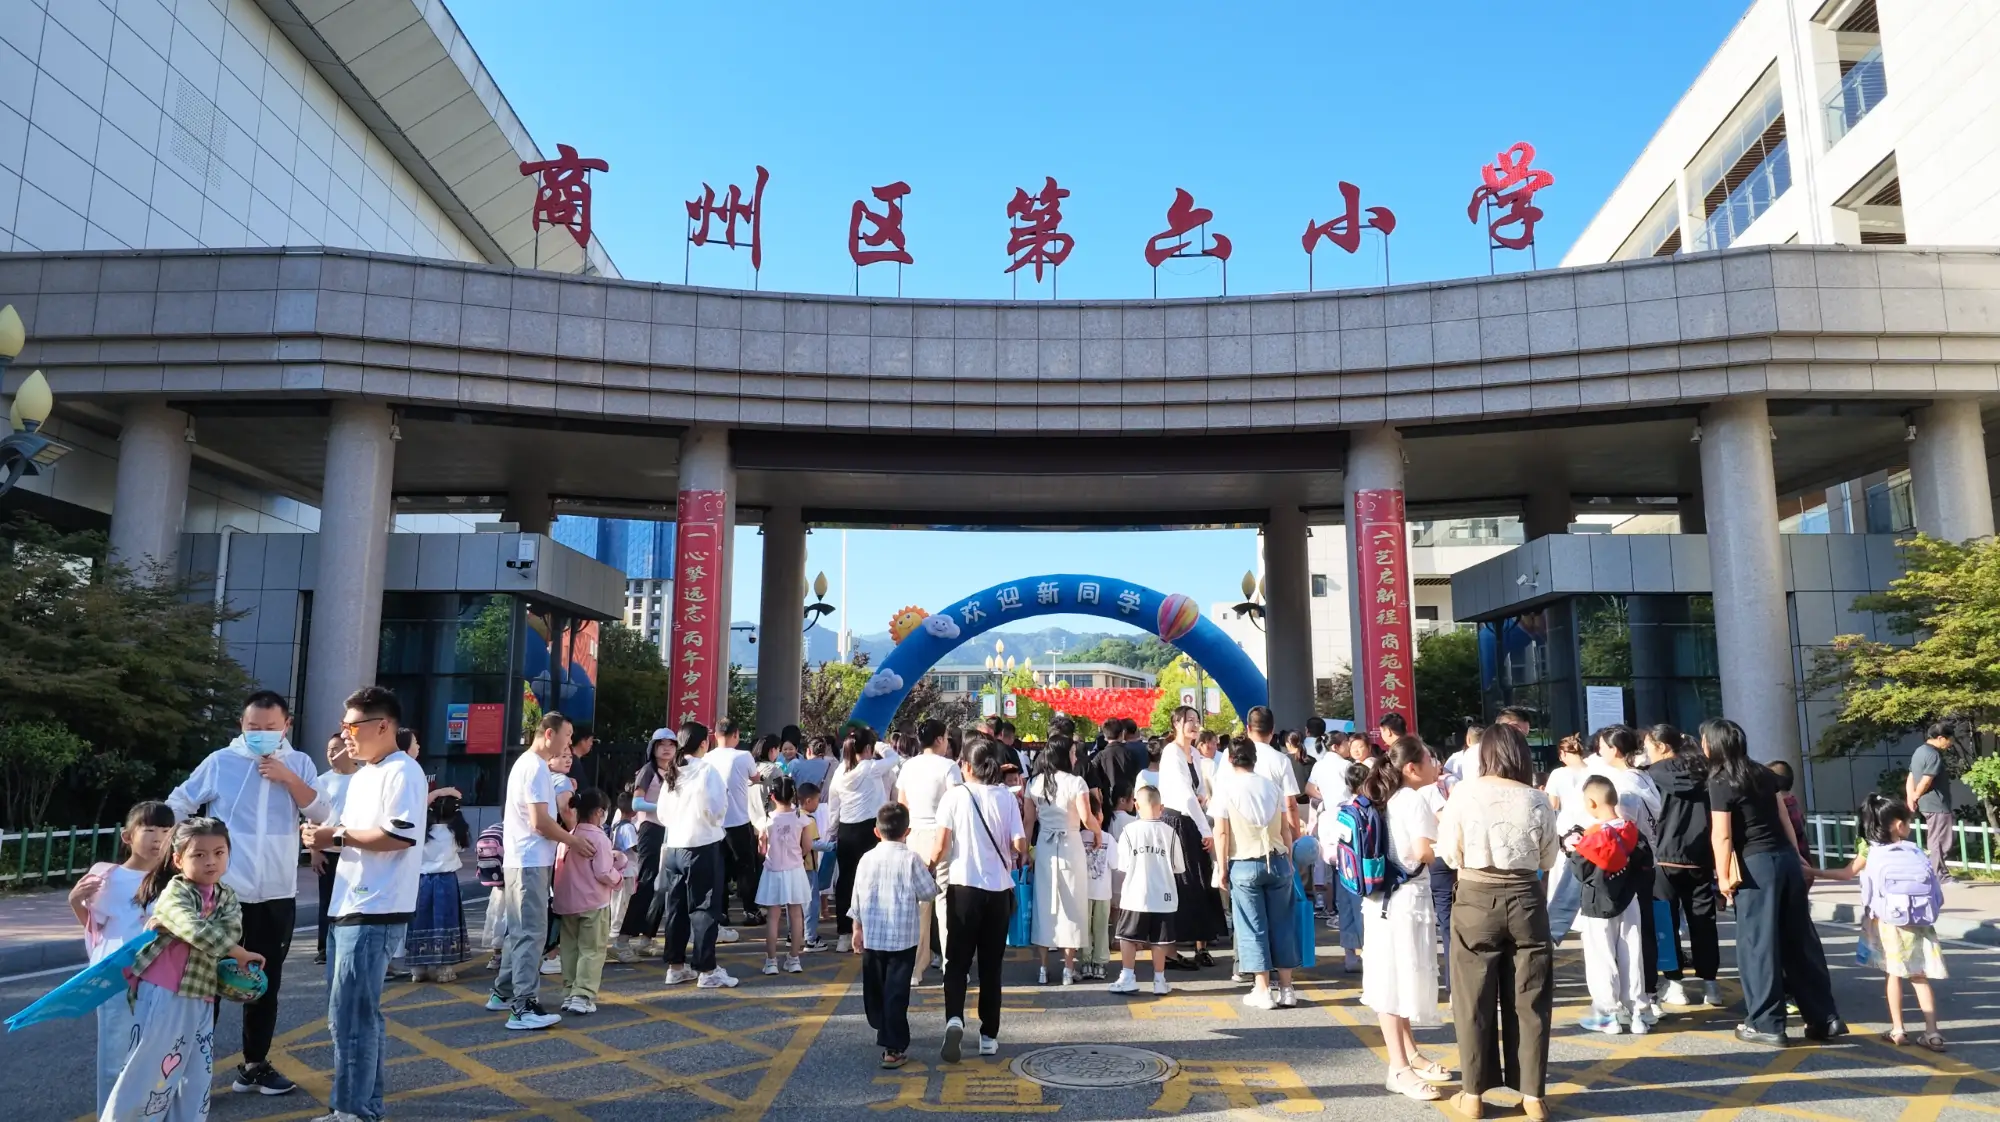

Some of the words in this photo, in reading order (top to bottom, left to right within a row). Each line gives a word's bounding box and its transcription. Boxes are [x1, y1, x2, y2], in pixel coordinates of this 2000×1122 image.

[519, 141, 1554, 284] 商州区第六小学
[959, 581, 1141, 625] 欢迎新同学
[1132, 845, 1166, 857] ACTIVE
